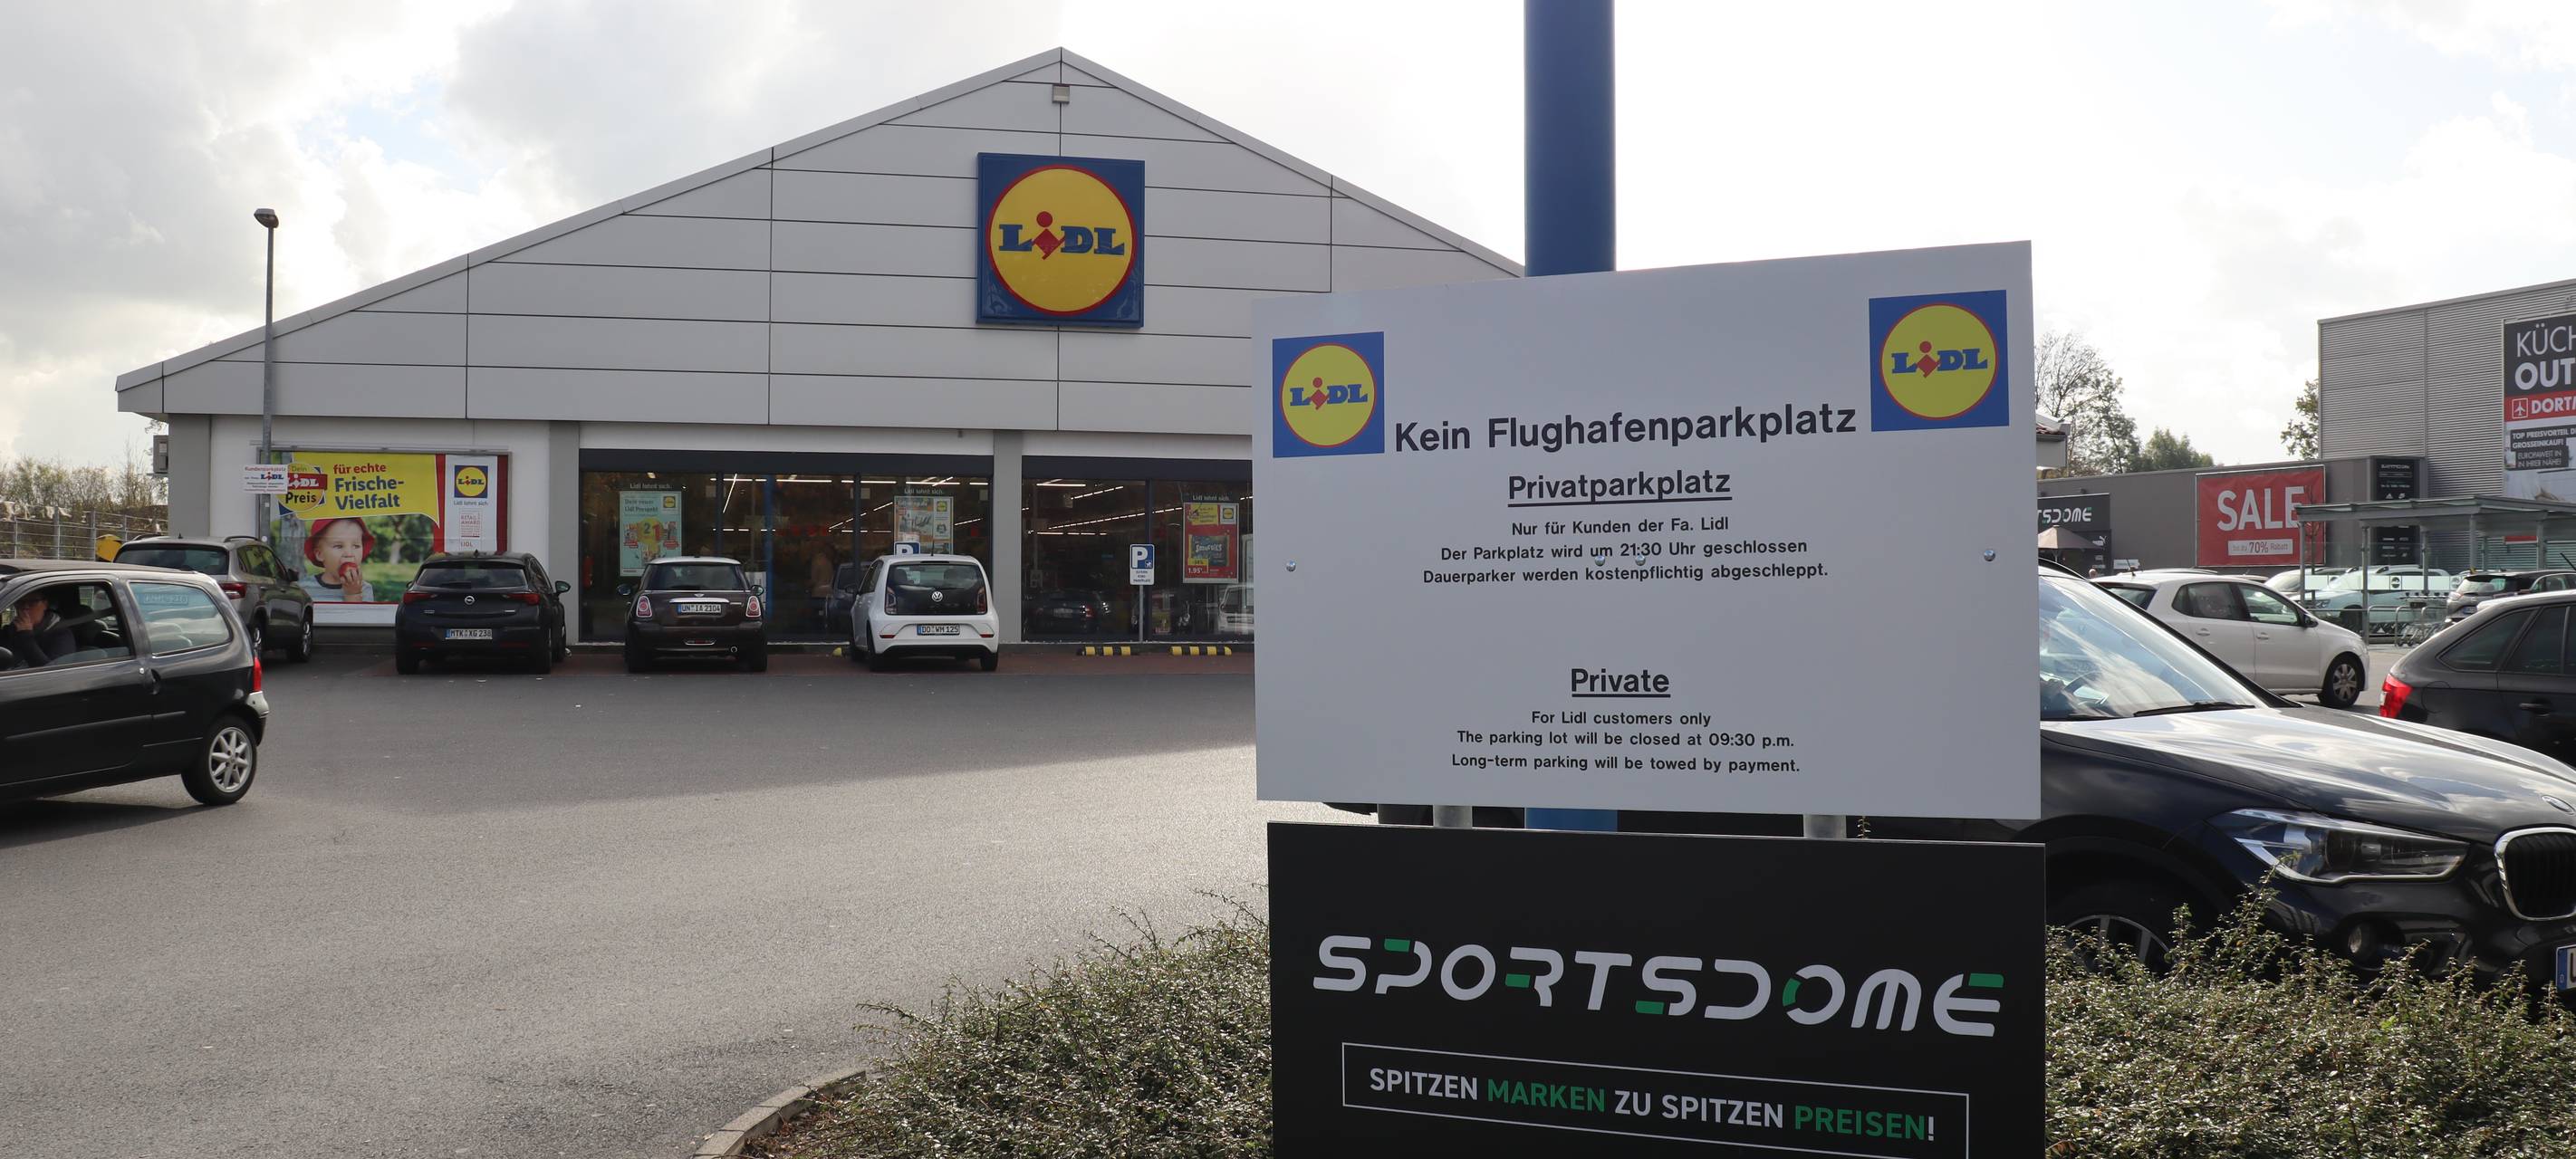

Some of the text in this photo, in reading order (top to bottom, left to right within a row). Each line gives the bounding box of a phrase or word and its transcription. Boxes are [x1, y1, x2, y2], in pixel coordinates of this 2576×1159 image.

[1396, 403, 1857, 453] Kein Flughafenparkplatz
[2526, 429, 2569, 438] PREISVORTEIL
[333, 463, 387, 474] für echte
[335, 475, 404, 493] Frische-
[1508, 470, 1731, 503] Privatparkplatz
[285, 492, 317, 504] Preis
[335, 493, 400, 510] Vielfalt
[2216, 486, 2305, 532] SALE
[1513, 517, 1728, 536] Nur für Kunden der Fa. Lidl
[1441, 541, 1808, 562] Der Parkplatz wird um 21:30 Uhr geschlossen
[2249, 541, 2269, 553] 70%
[1132, 546, 1149, 569] P
[1423, 562, 1828, 586] Dauerparker werden kostenpflichtig abgeschleppt.
[1572, 668, 1669, 694] Private
[1532, 711, 1712, 728] For Lidl customers only
[1457, 731, 1794, 750] The parking lot will be closed at 09:30 p.m.
[1452, 754, 1801, 774] Long-term parking will be towed by payment.
[1313, 934, 2004, 1038] SPORTSDOME
[1370, 1068, 1936, 1142] SPITZEN MARKEN ZU SPITZEN PREISEN!
